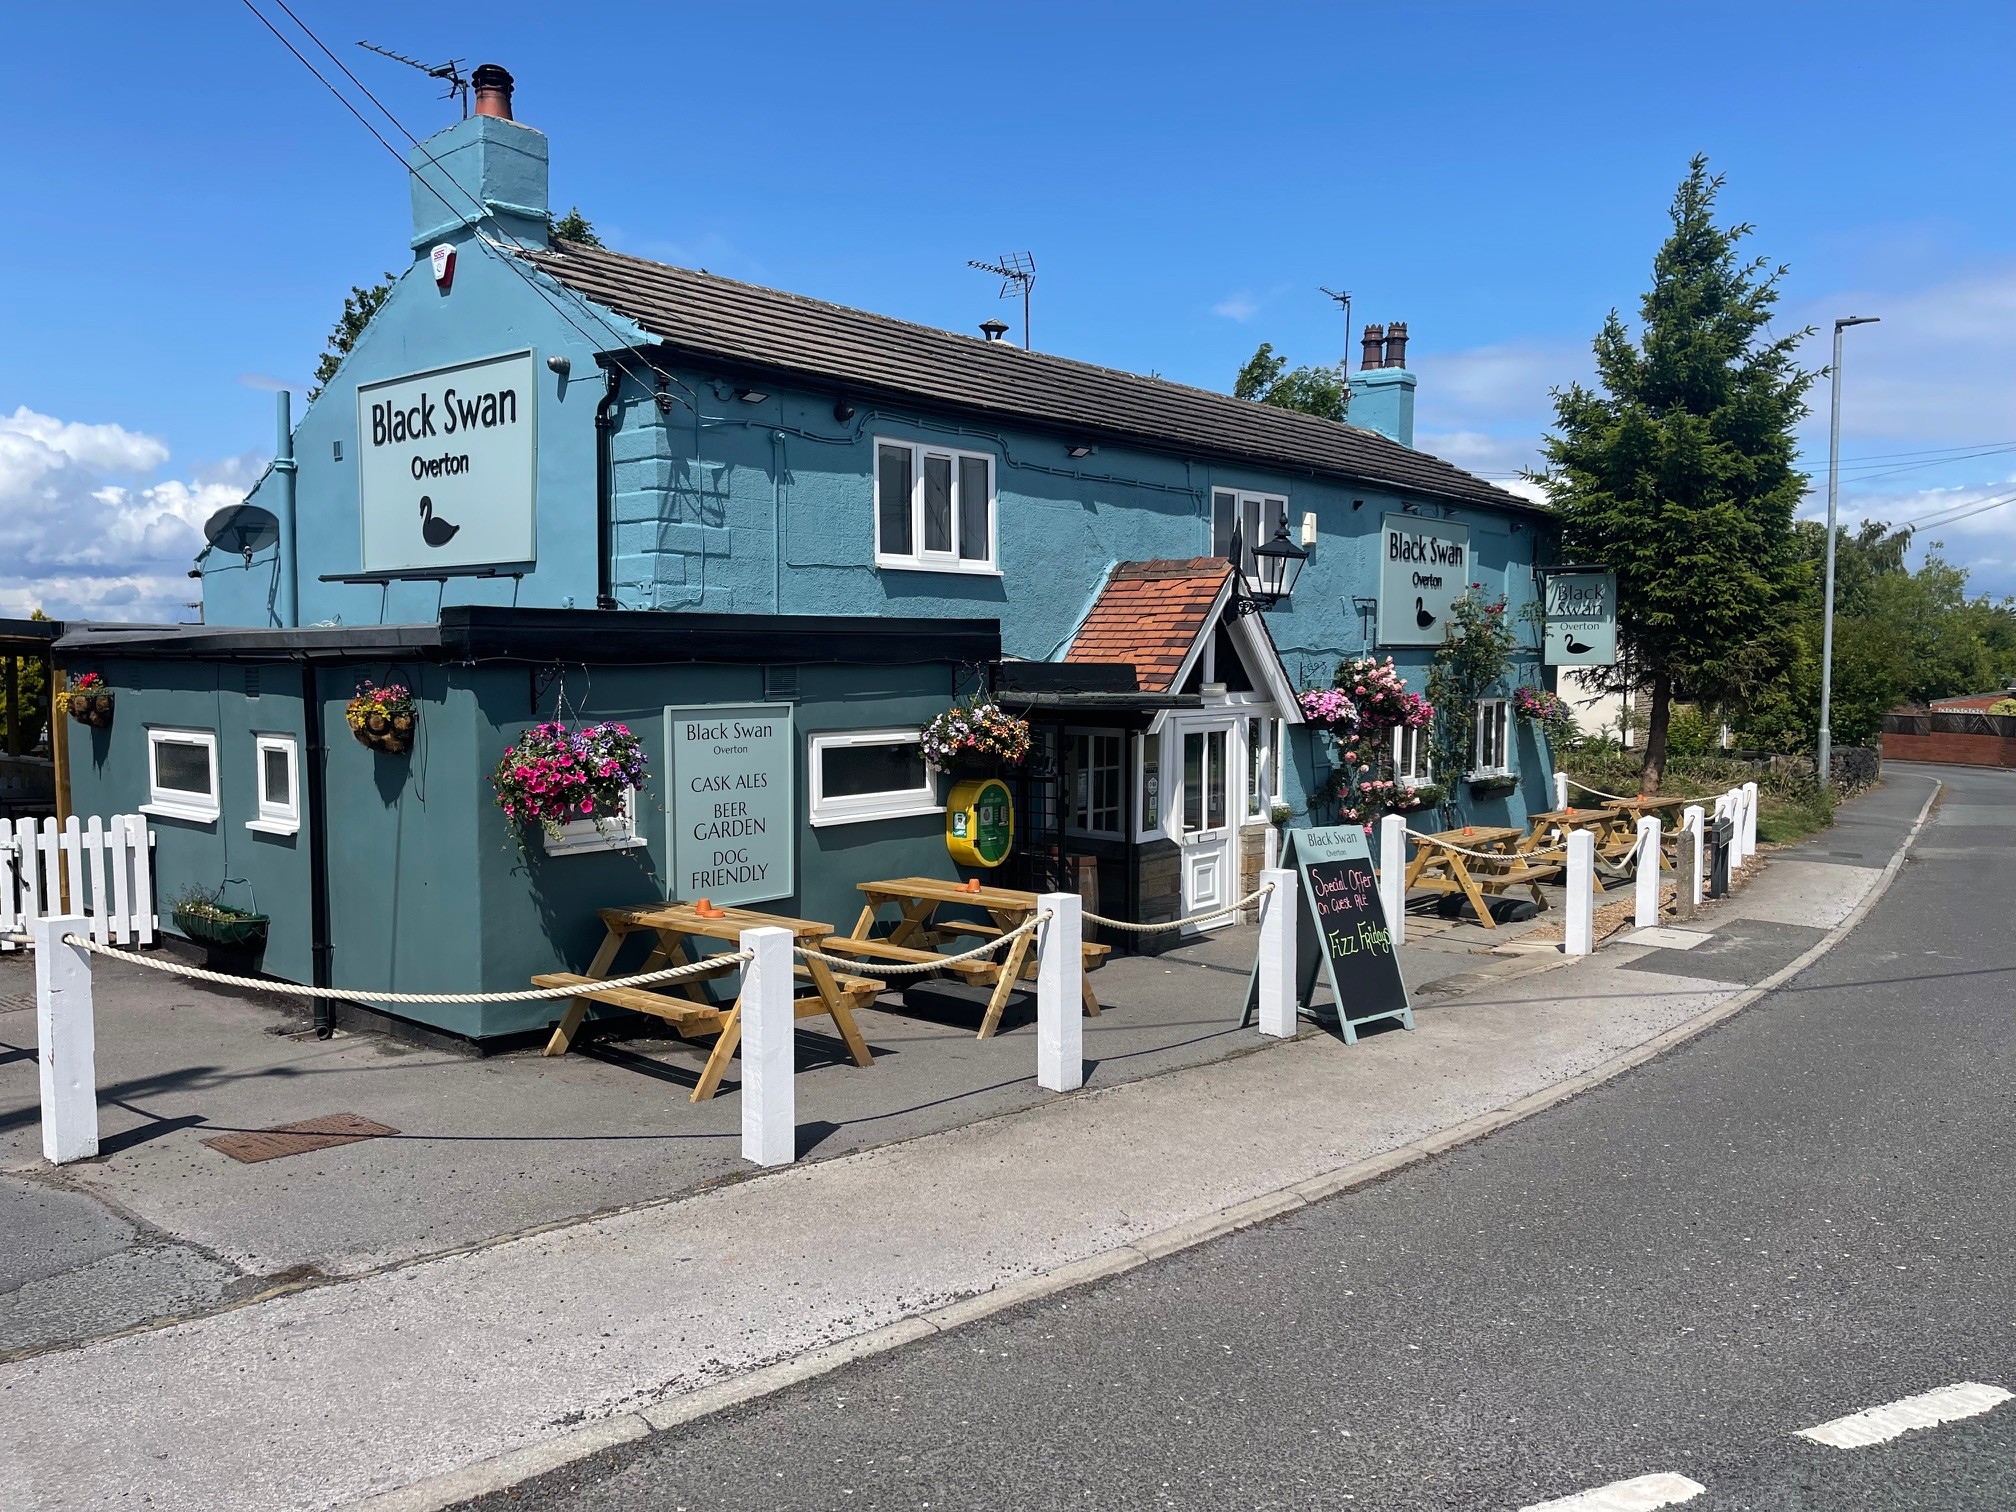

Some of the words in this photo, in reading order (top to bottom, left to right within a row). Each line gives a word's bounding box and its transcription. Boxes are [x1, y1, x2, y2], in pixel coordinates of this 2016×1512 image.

[372, 393, 436, 446] Black
[444, 388, 516, 434] Swan
[411, 452, 469, 480] Overton
[1390, 532, 1427, 564] Black
[1430, 537, 1463, 567] Swan
[1412, 571, 1443, 590] Overton
[1558, 584, 1604, 601] Black
[1557, 601, 1603, 617] Swan
[1560, 622, 1600, 631] Overton
[687, 722, 728, 741] Black
[733, 722, 772, 739] Swan
[713, 745, 748, 755] Overton
[691, 775, 731, 793] CASK
[735, 772, 768, 789] ALES
[714, 801, 748, 819] BEER
[693, 817, 766, 841] GARDEN
[1307, 832, 1333, 847] Black
[1333, 831, 1358, 844] Swan
[713, 848, 748, 867] DOG
[1325, 849, 1347, 857] Overton
[692, 863, 769, 889] FRIENDLY
[1312, 868, 1349, 897] Special
[1348, 869, 1372, 893] Offer
[1317, 902, 1331, 915] On
[1331, 896, 1353, 913] Guest
